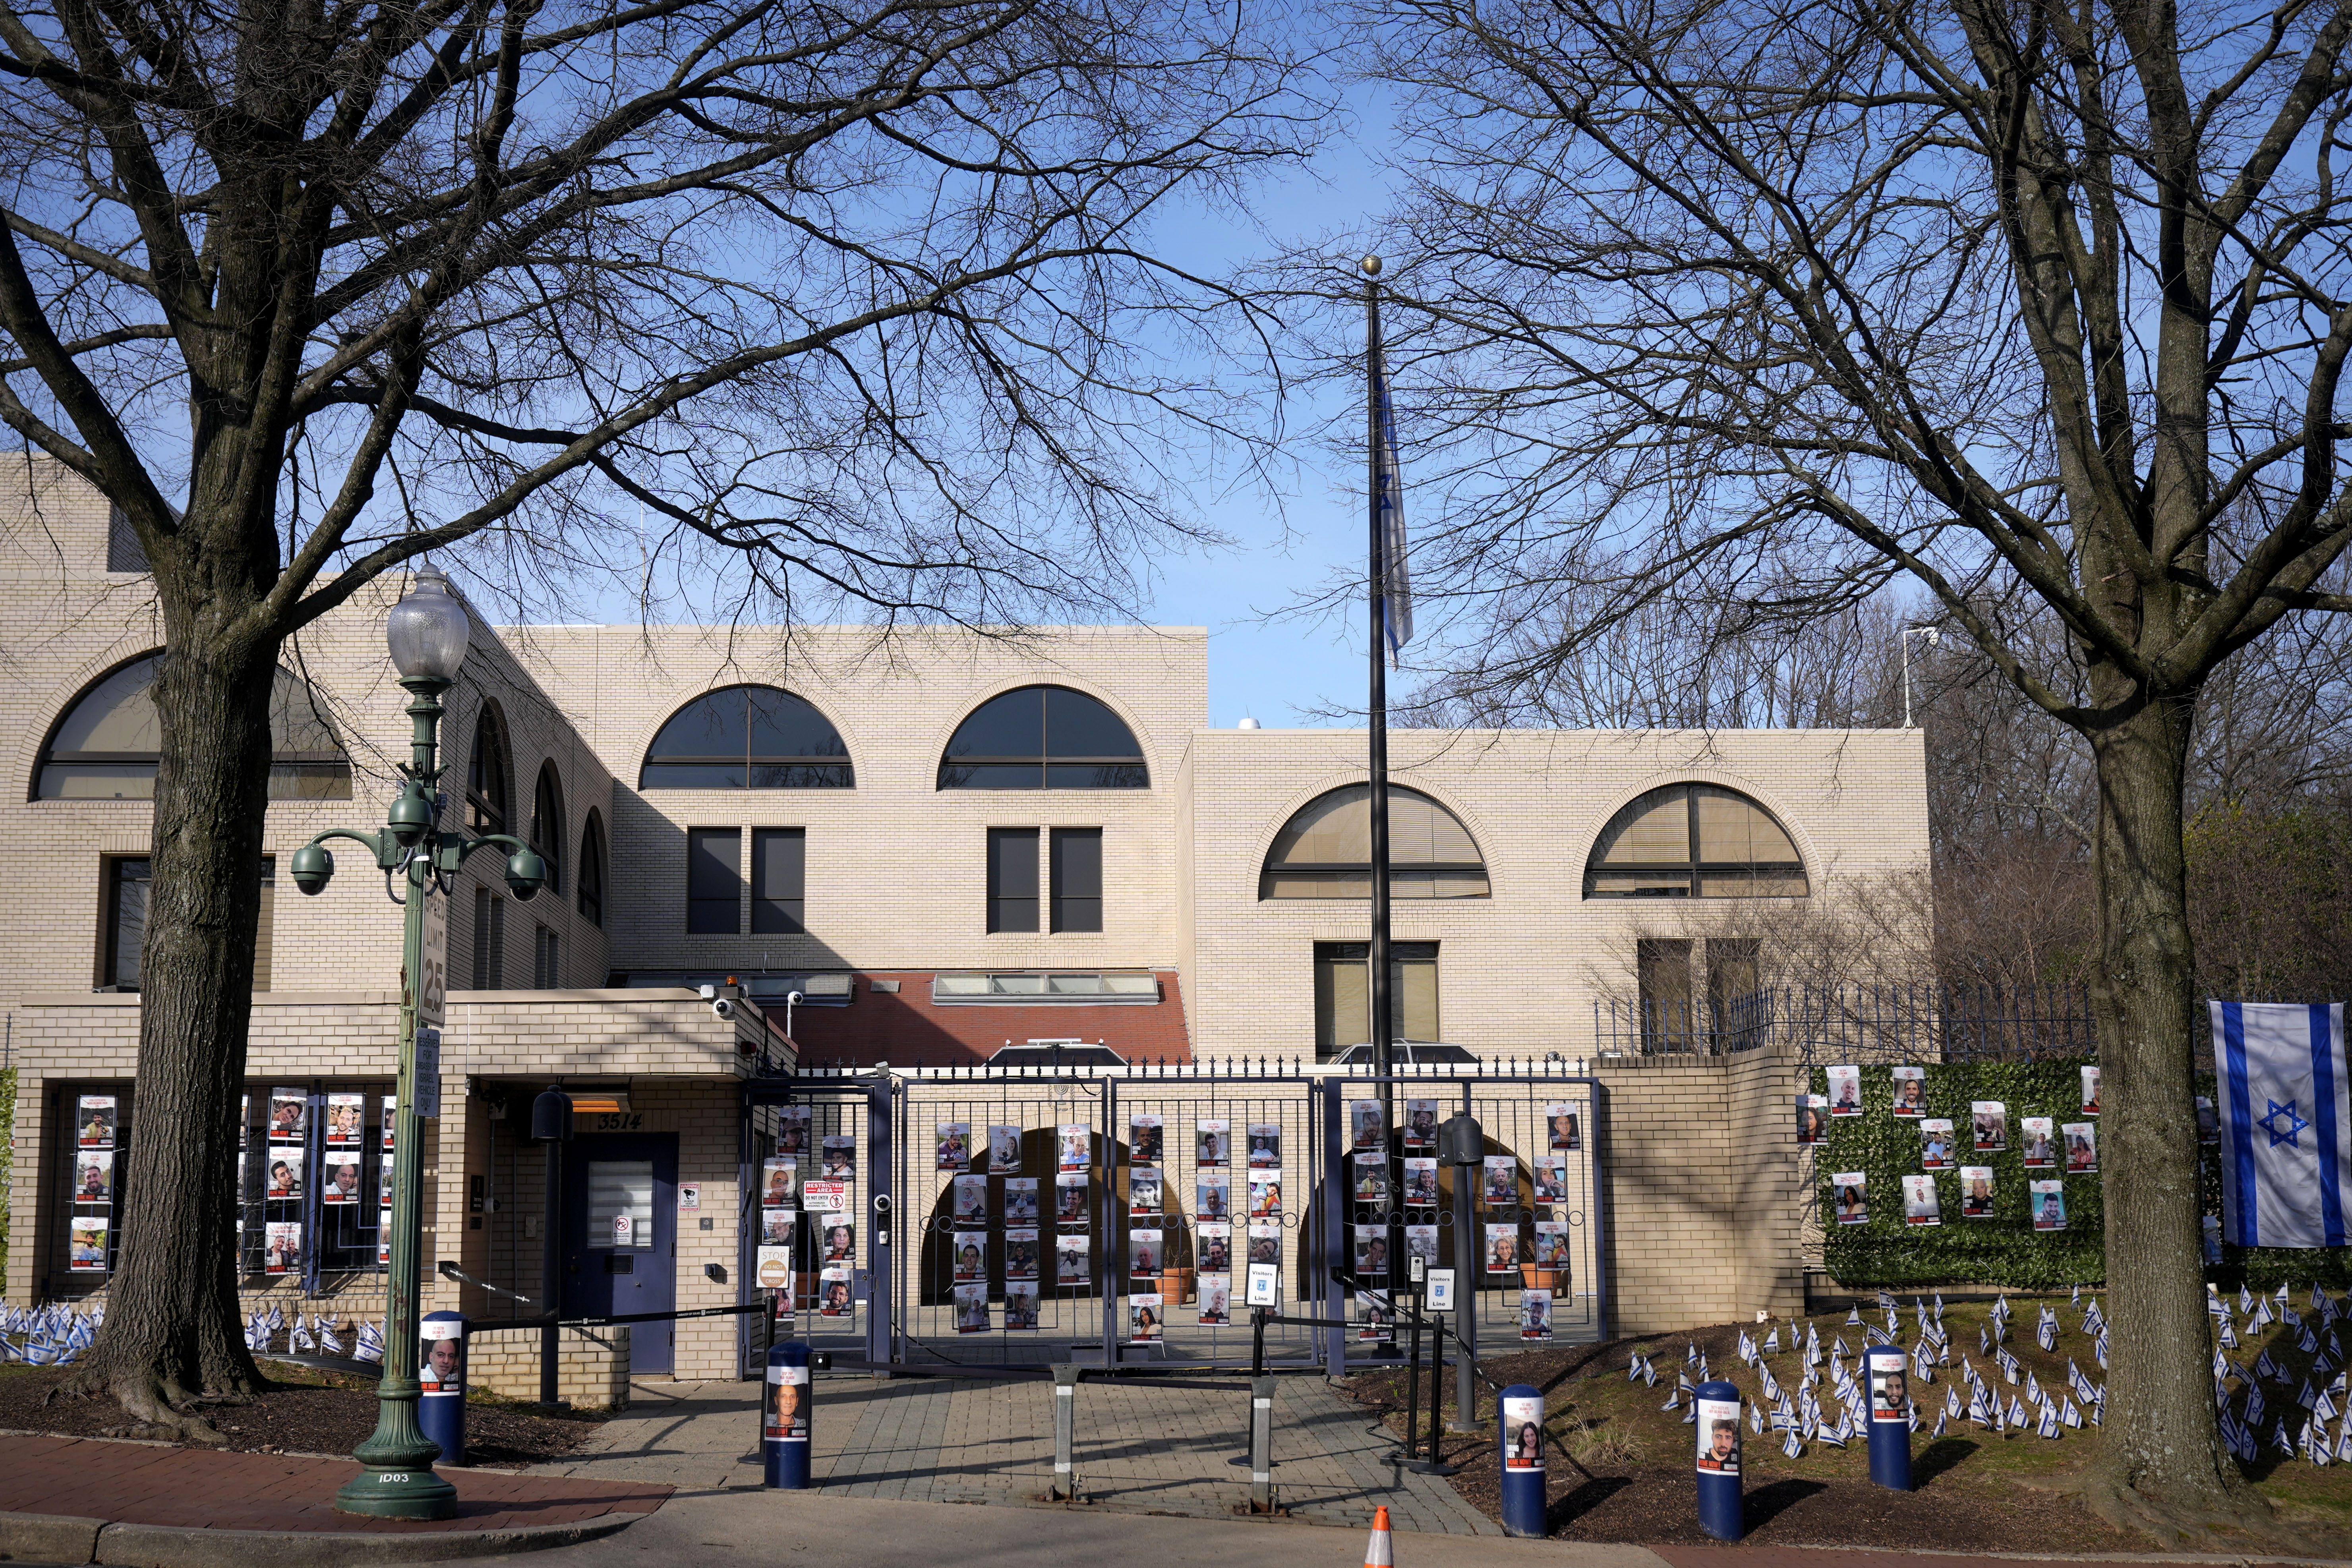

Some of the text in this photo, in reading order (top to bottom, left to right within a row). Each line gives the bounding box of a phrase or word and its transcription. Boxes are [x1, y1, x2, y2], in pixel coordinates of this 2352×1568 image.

[426, 895, 445, 921] SPEED
[427, 924, 443, 952] LIMIT
[424, 958, 443, 1012] 25
[417, 1036, 439, 1048] RESERVED
[423, 1050, 432, 1060] FOR
[416, 1061, 432, 1071] EMBASSY
[419, 1073, 434, 1083] ISRAEL
[418, 1085, 435, 1095] VEHICLE
[420, 1098, 431, 1107] ONLY
[598, 1114, 642, 1129] 3514
[379, 1474, 409, 1483] ID03
